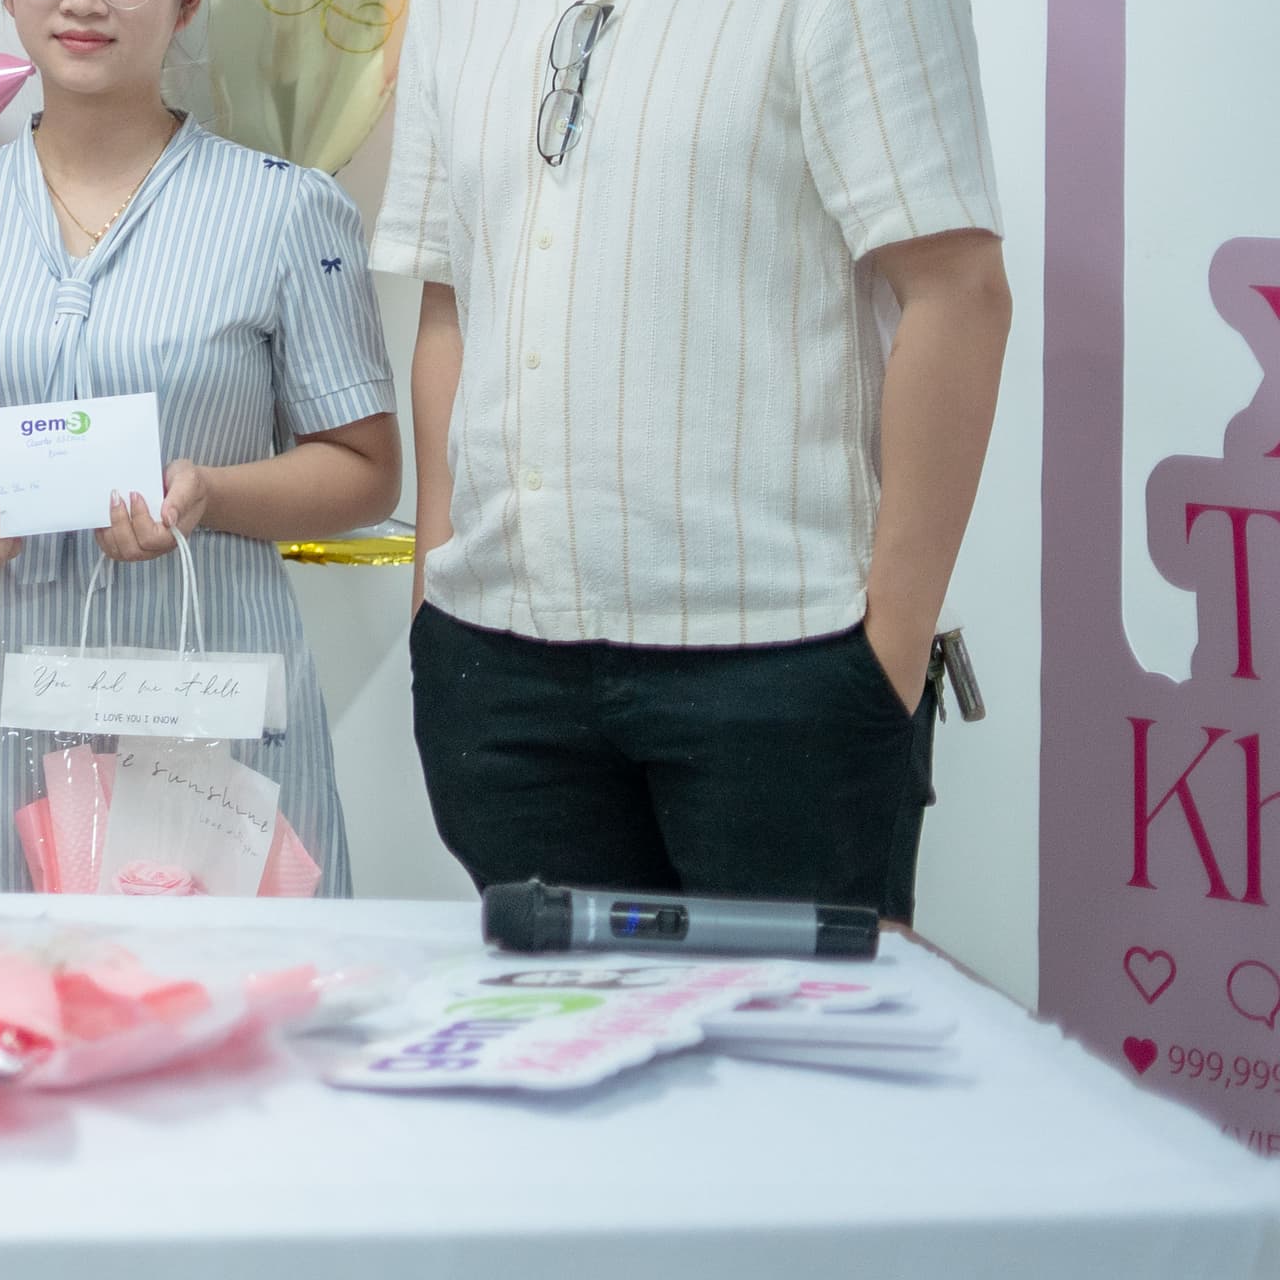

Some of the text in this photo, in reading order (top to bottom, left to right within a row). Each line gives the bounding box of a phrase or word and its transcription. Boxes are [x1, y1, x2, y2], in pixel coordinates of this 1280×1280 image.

[103, 713, 123, 722] LOVE
[127, 714, 141, 723] YOU
[152, 715, 179, 725] KNOW
